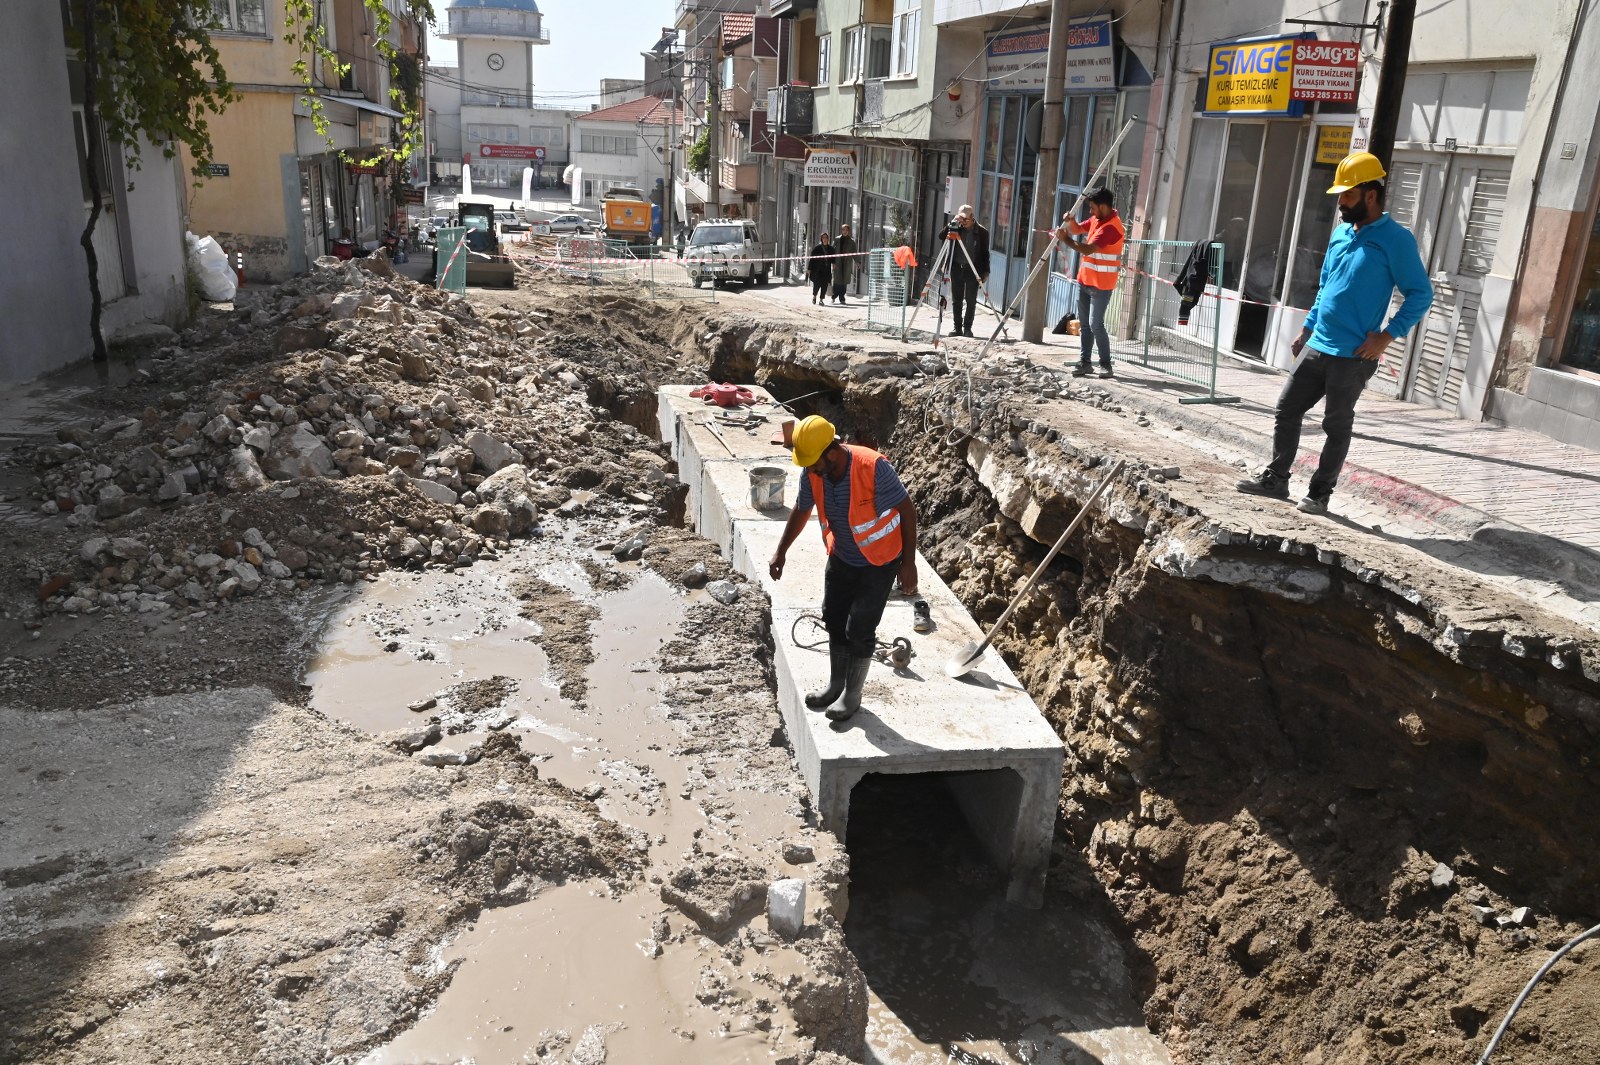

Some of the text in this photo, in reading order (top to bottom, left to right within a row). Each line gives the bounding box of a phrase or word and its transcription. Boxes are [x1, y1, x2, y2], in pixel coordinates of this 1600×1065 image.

[1296, 68, 1354, 78] KURU TEMİZLEME
[1216, 77, 1279, 91] KURU TEMİZLEME
[1298, 79, 1350, 88] ÇAMAŞIR YIKAMA
[1294, 90, 1299, 98] 0
[1301, 90, 1315, 98] 535
[1316, 91, 1331, 99] 285
[1343, 92, 1352, 100] 31
[1217, 94, 1273, 107] ÇAMAŞIR YIKAMA
[811, 155, 850, 165] PERDECİ
[807, 165, 855, 175] ERCÜMENT
